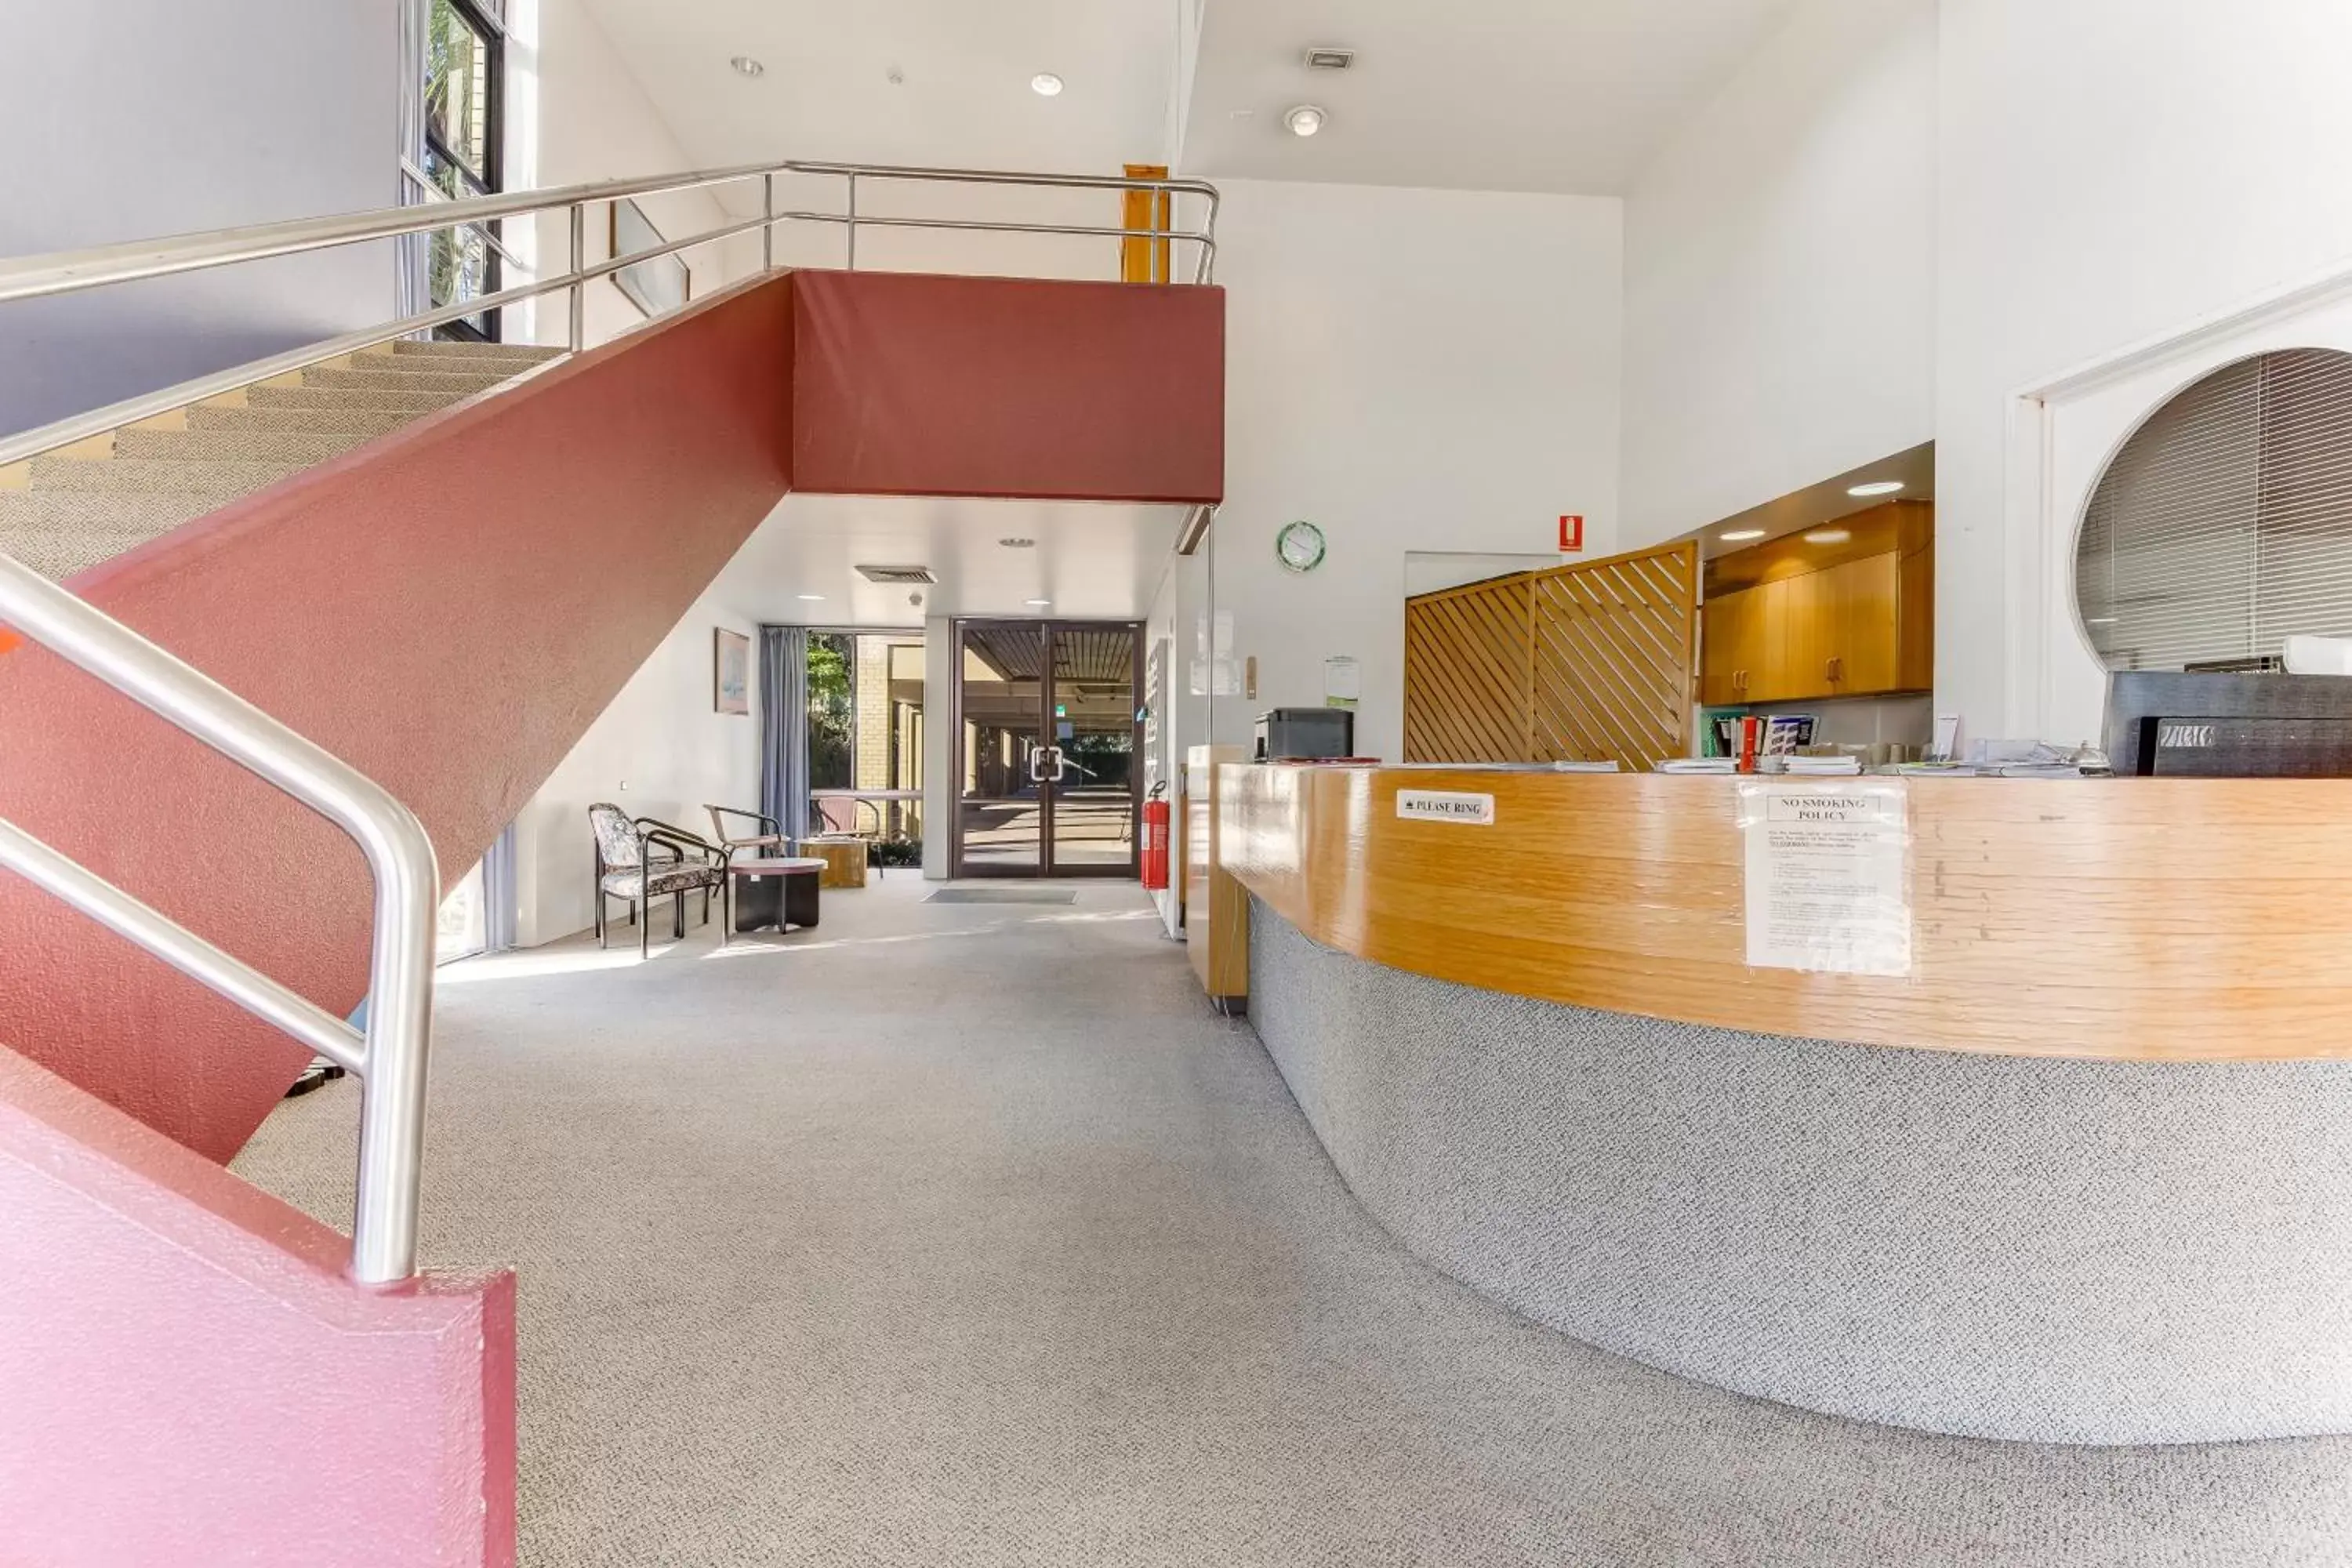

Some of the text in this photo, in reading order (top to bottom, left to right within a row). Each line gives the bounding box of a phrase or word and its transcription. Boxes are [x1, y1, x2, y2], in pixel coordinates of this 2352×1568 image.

[1417, 800, 1481, 815] PLEASE RING
[1782, 798, 1866, 808] NO SMOKING
[1798, 811, 1847, 820] POLICY
